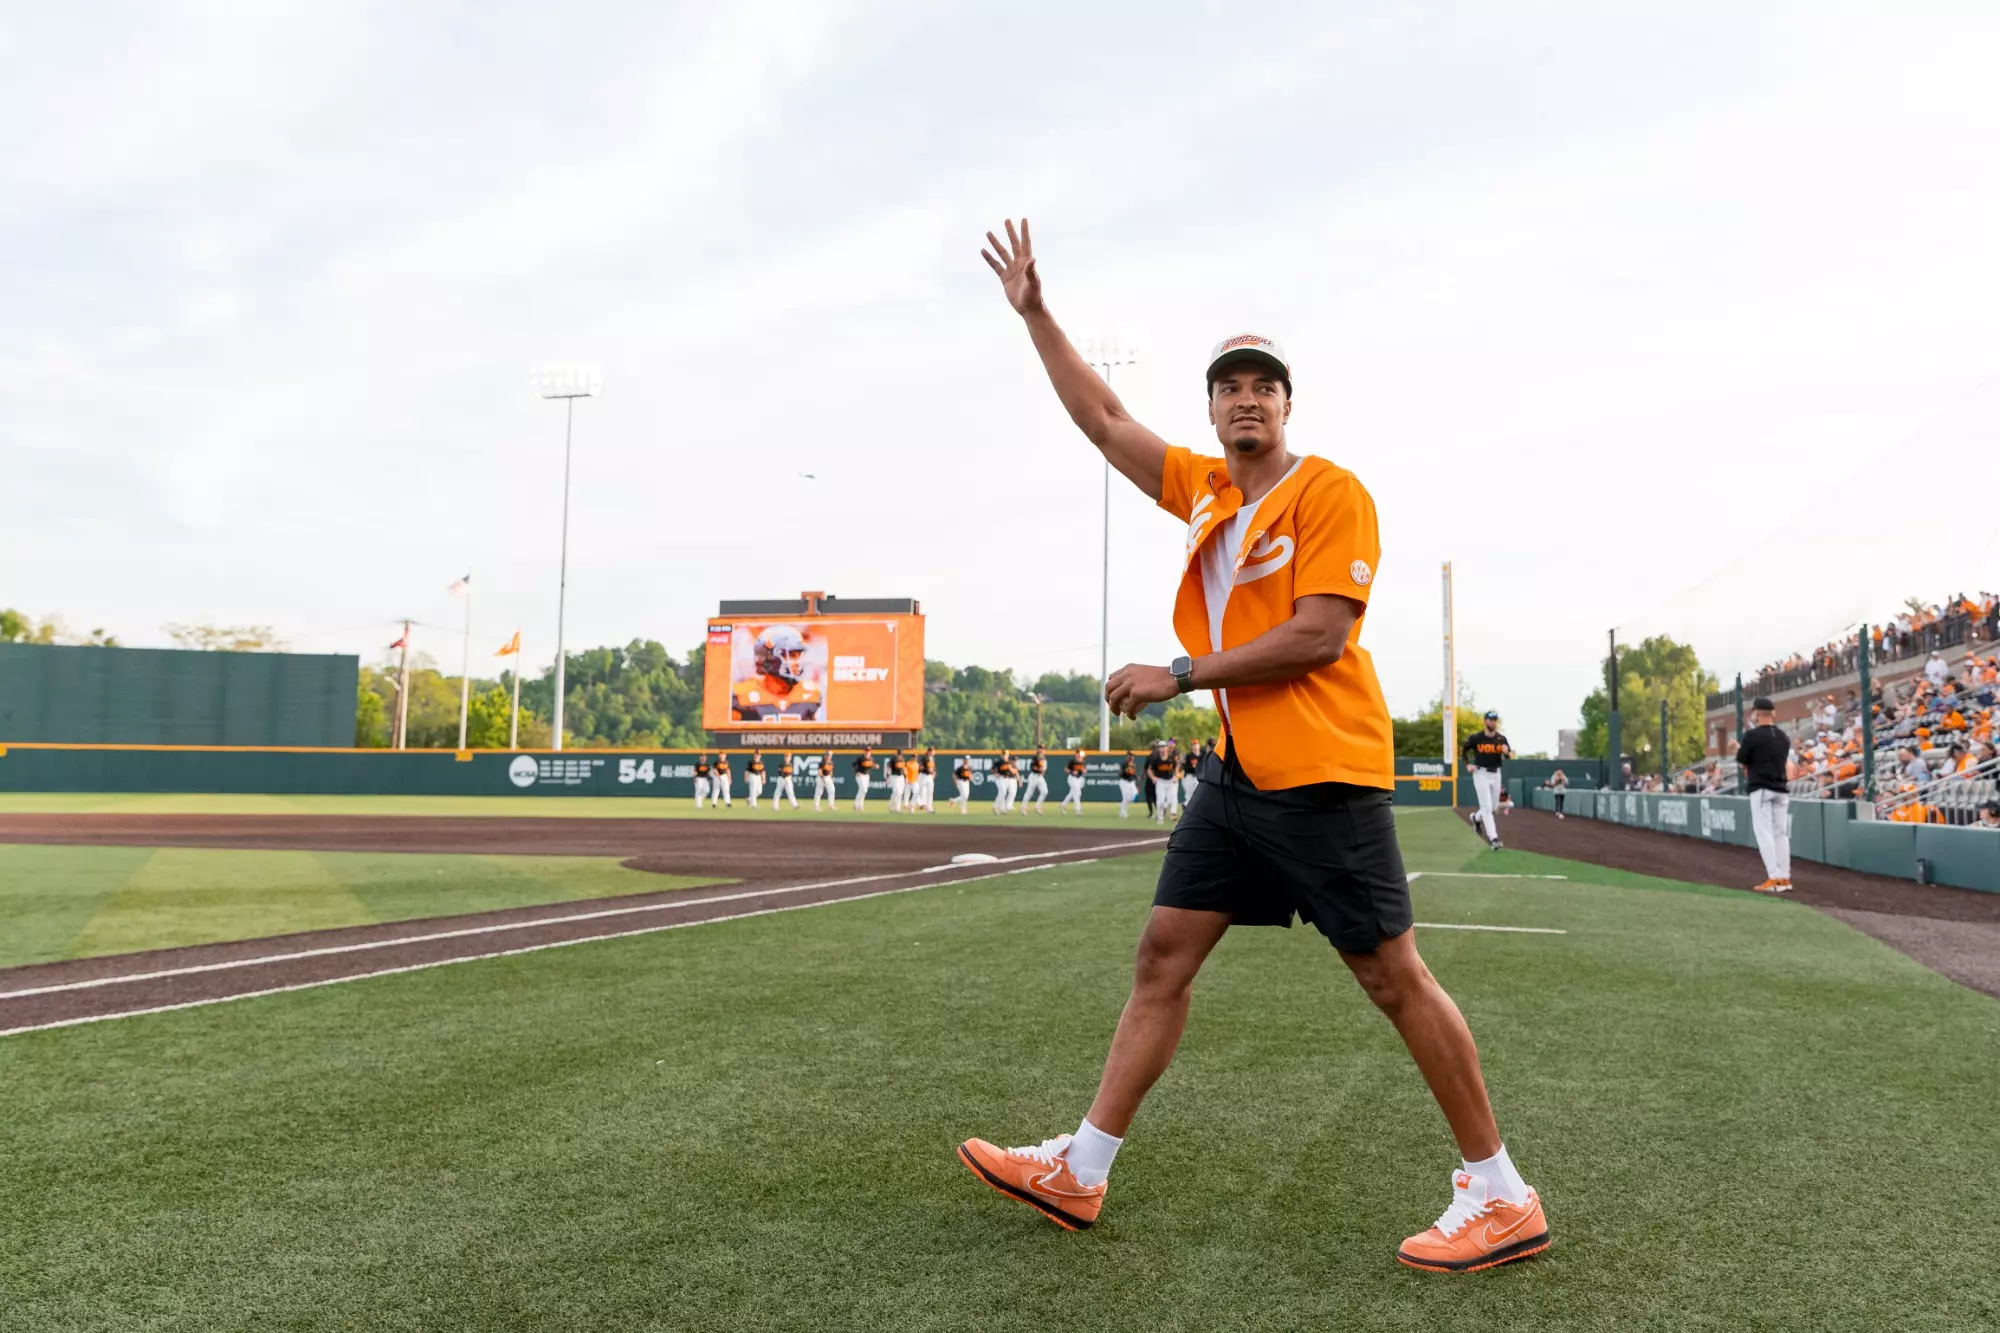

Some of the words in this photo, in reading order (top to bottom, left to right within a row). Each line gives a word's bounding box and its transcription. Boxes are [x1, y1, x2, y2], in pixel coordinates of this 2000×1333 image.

[741, 733, 785, 745] LINDSEY
[787, 733, 831, 745] NELSON
[833, 733, 882, 745] STADIUM
[618, 759, 656, 783] 54
